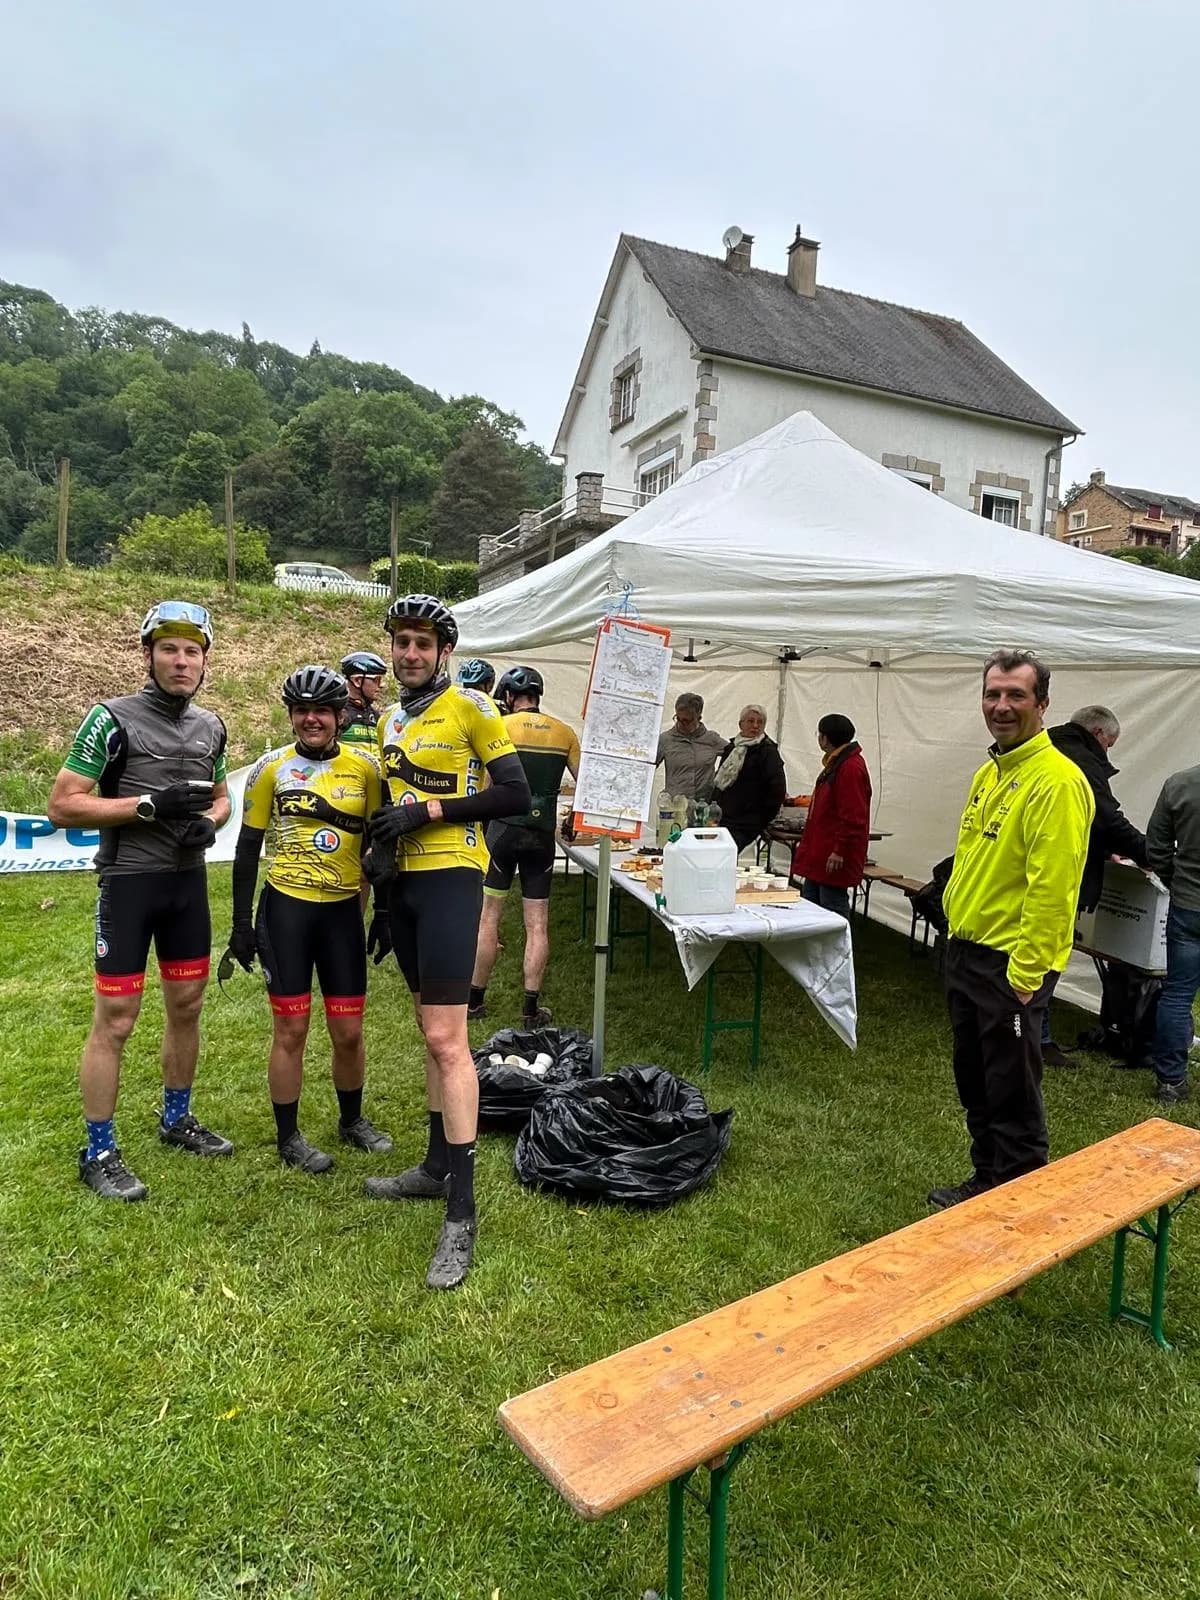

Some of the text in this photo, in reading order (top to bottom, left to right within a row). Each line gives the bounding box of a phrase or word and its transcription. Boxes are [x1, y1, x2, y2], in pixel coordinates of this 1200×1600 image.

[413, 772, 451, 787] VC Lisieux
[1013, 1013, 1022, 1037] adidas
